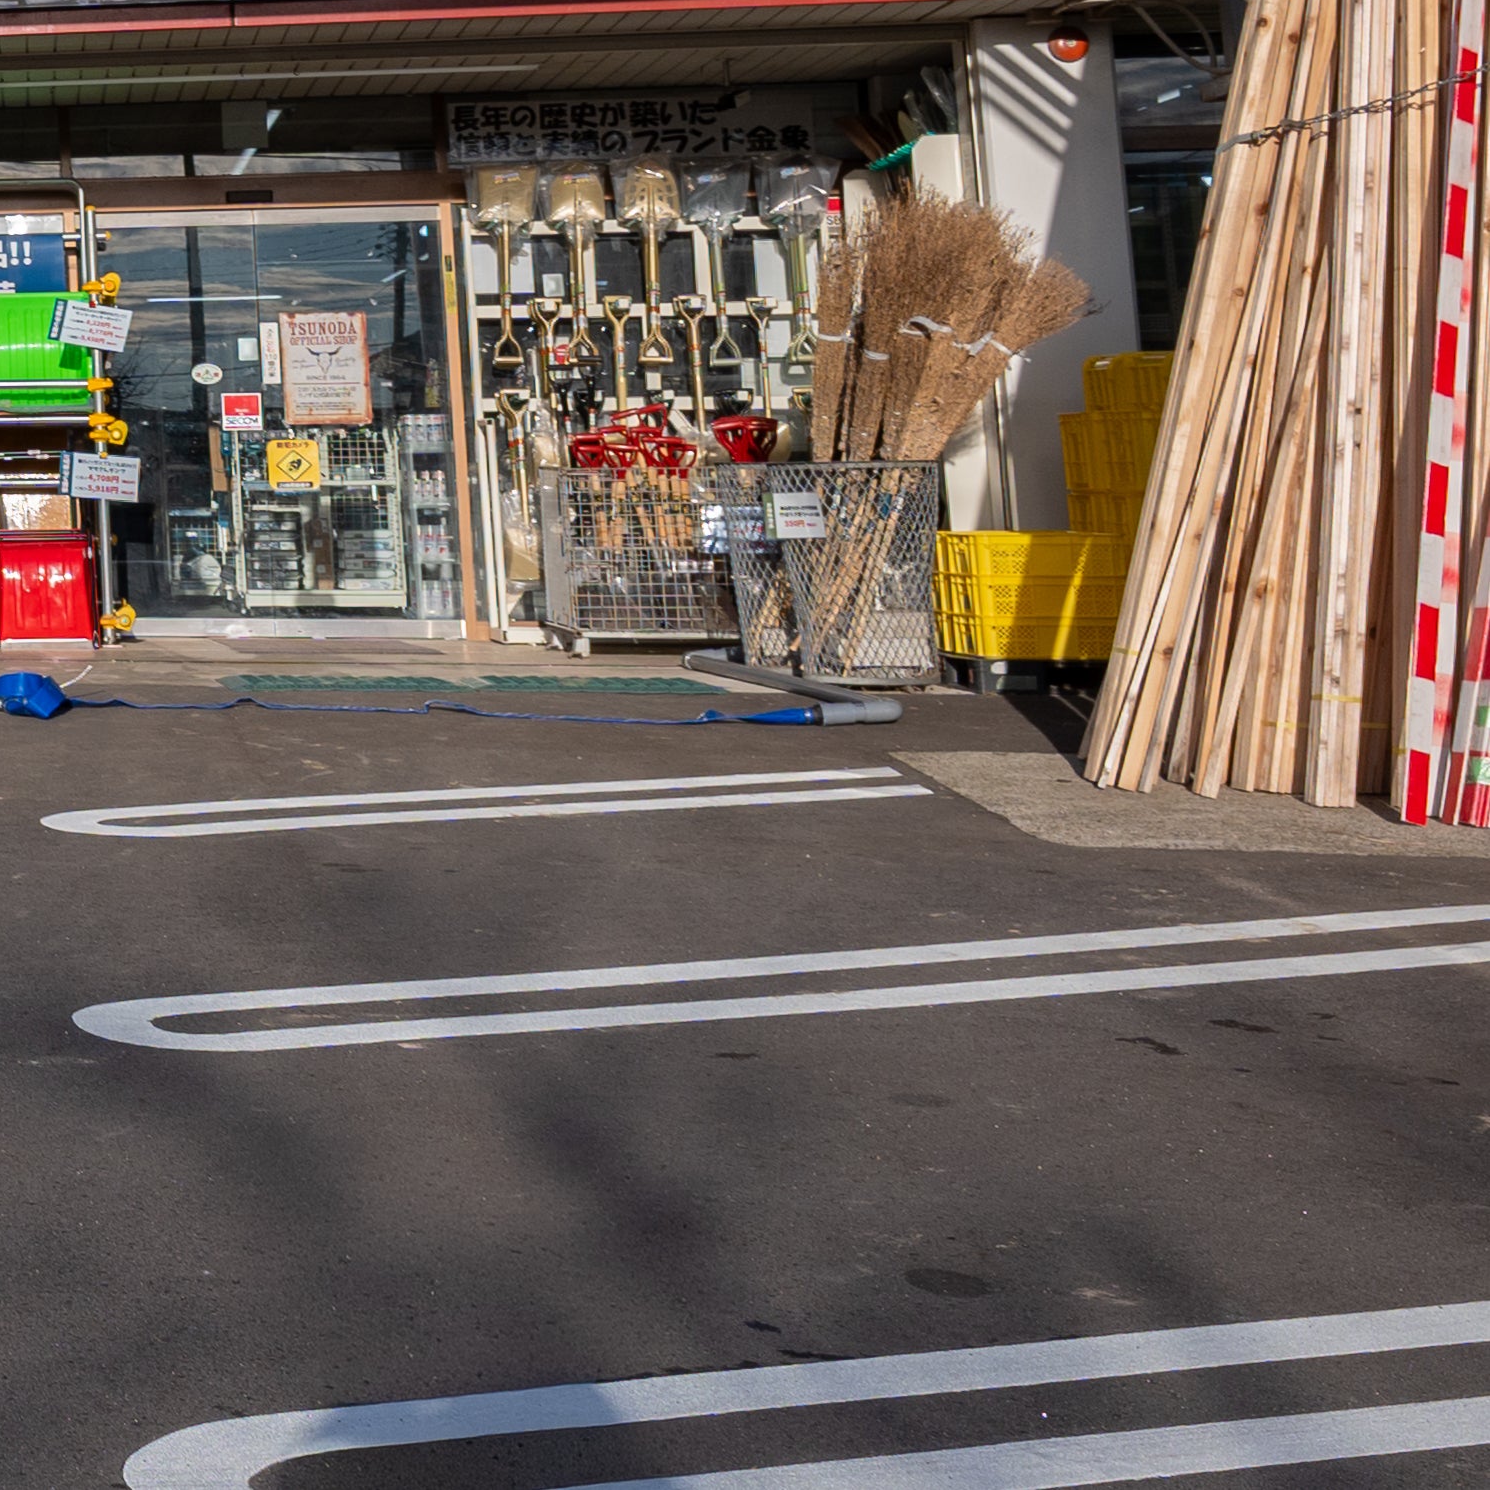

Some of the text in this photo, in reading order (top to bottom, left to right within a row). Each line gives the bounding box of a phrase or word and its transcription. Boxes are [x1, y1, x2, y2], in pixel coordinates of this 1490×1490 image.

[451, 100, 719, 132] 長年の歴史が築いた
[288, 319, 358, 336] TSUNODA
[290, 335, 358, 346] OFFICIAL SHOP
[226, 416, 259, 425] SECOM
